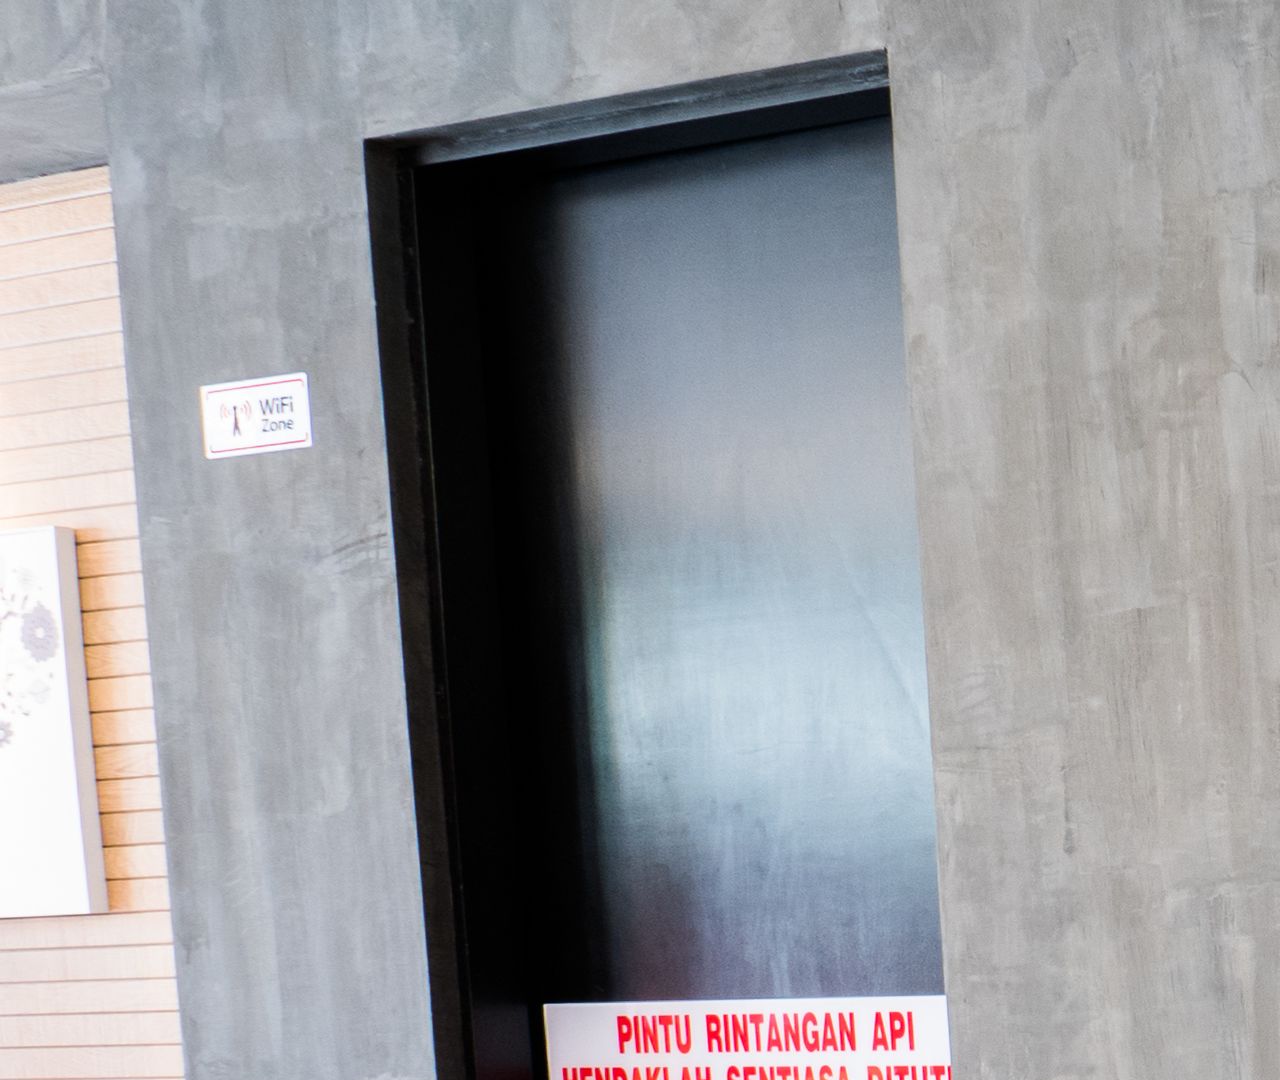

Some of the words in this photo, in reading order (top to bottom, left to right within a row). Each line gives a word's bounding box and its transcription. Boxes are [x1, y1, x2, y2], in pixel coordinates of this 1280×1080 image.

[259, 396, 294, 416] WiFi
[262, 418, 294, 433] Zone
[616, 1013, 692, 1055] PINTU
[706, 1012, 857, 1053] RINTANGAN
[872, 1011, 915, 1051] API
